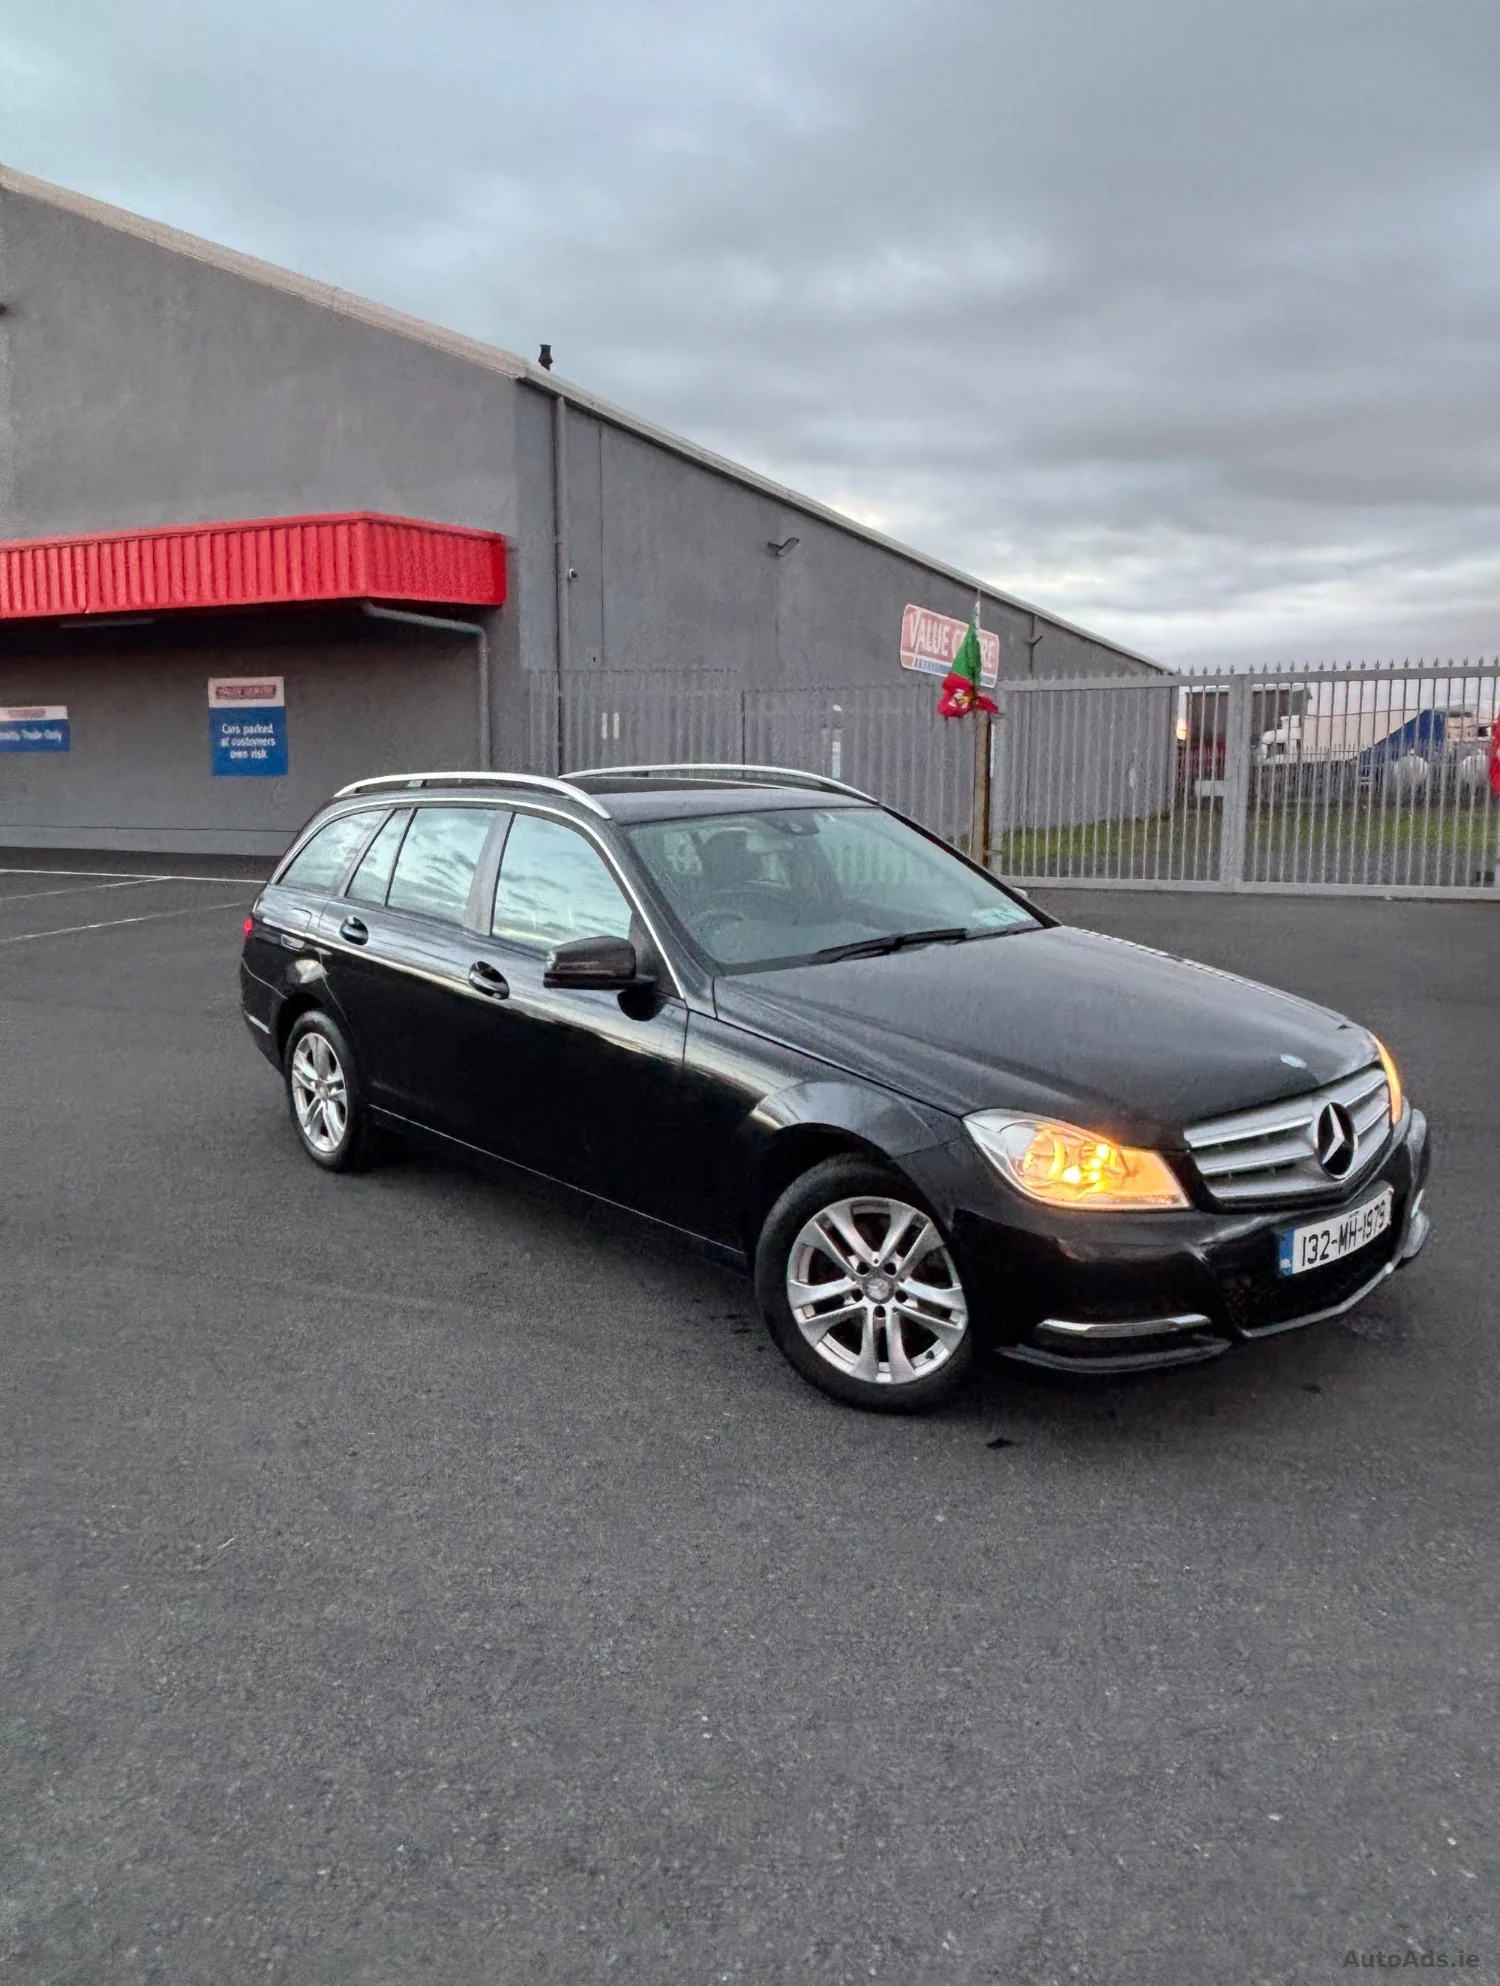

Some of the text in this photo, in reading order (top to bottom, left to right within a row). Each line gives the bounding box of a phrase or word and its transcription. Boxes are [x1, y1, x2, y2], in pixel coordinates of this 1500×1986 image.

[909, 609, 951, 656] VALUE
[222, 723, 274, 735] Cars parked
[220, 737, 276, 747] at customers
[251, 749, 268, 759] risk
